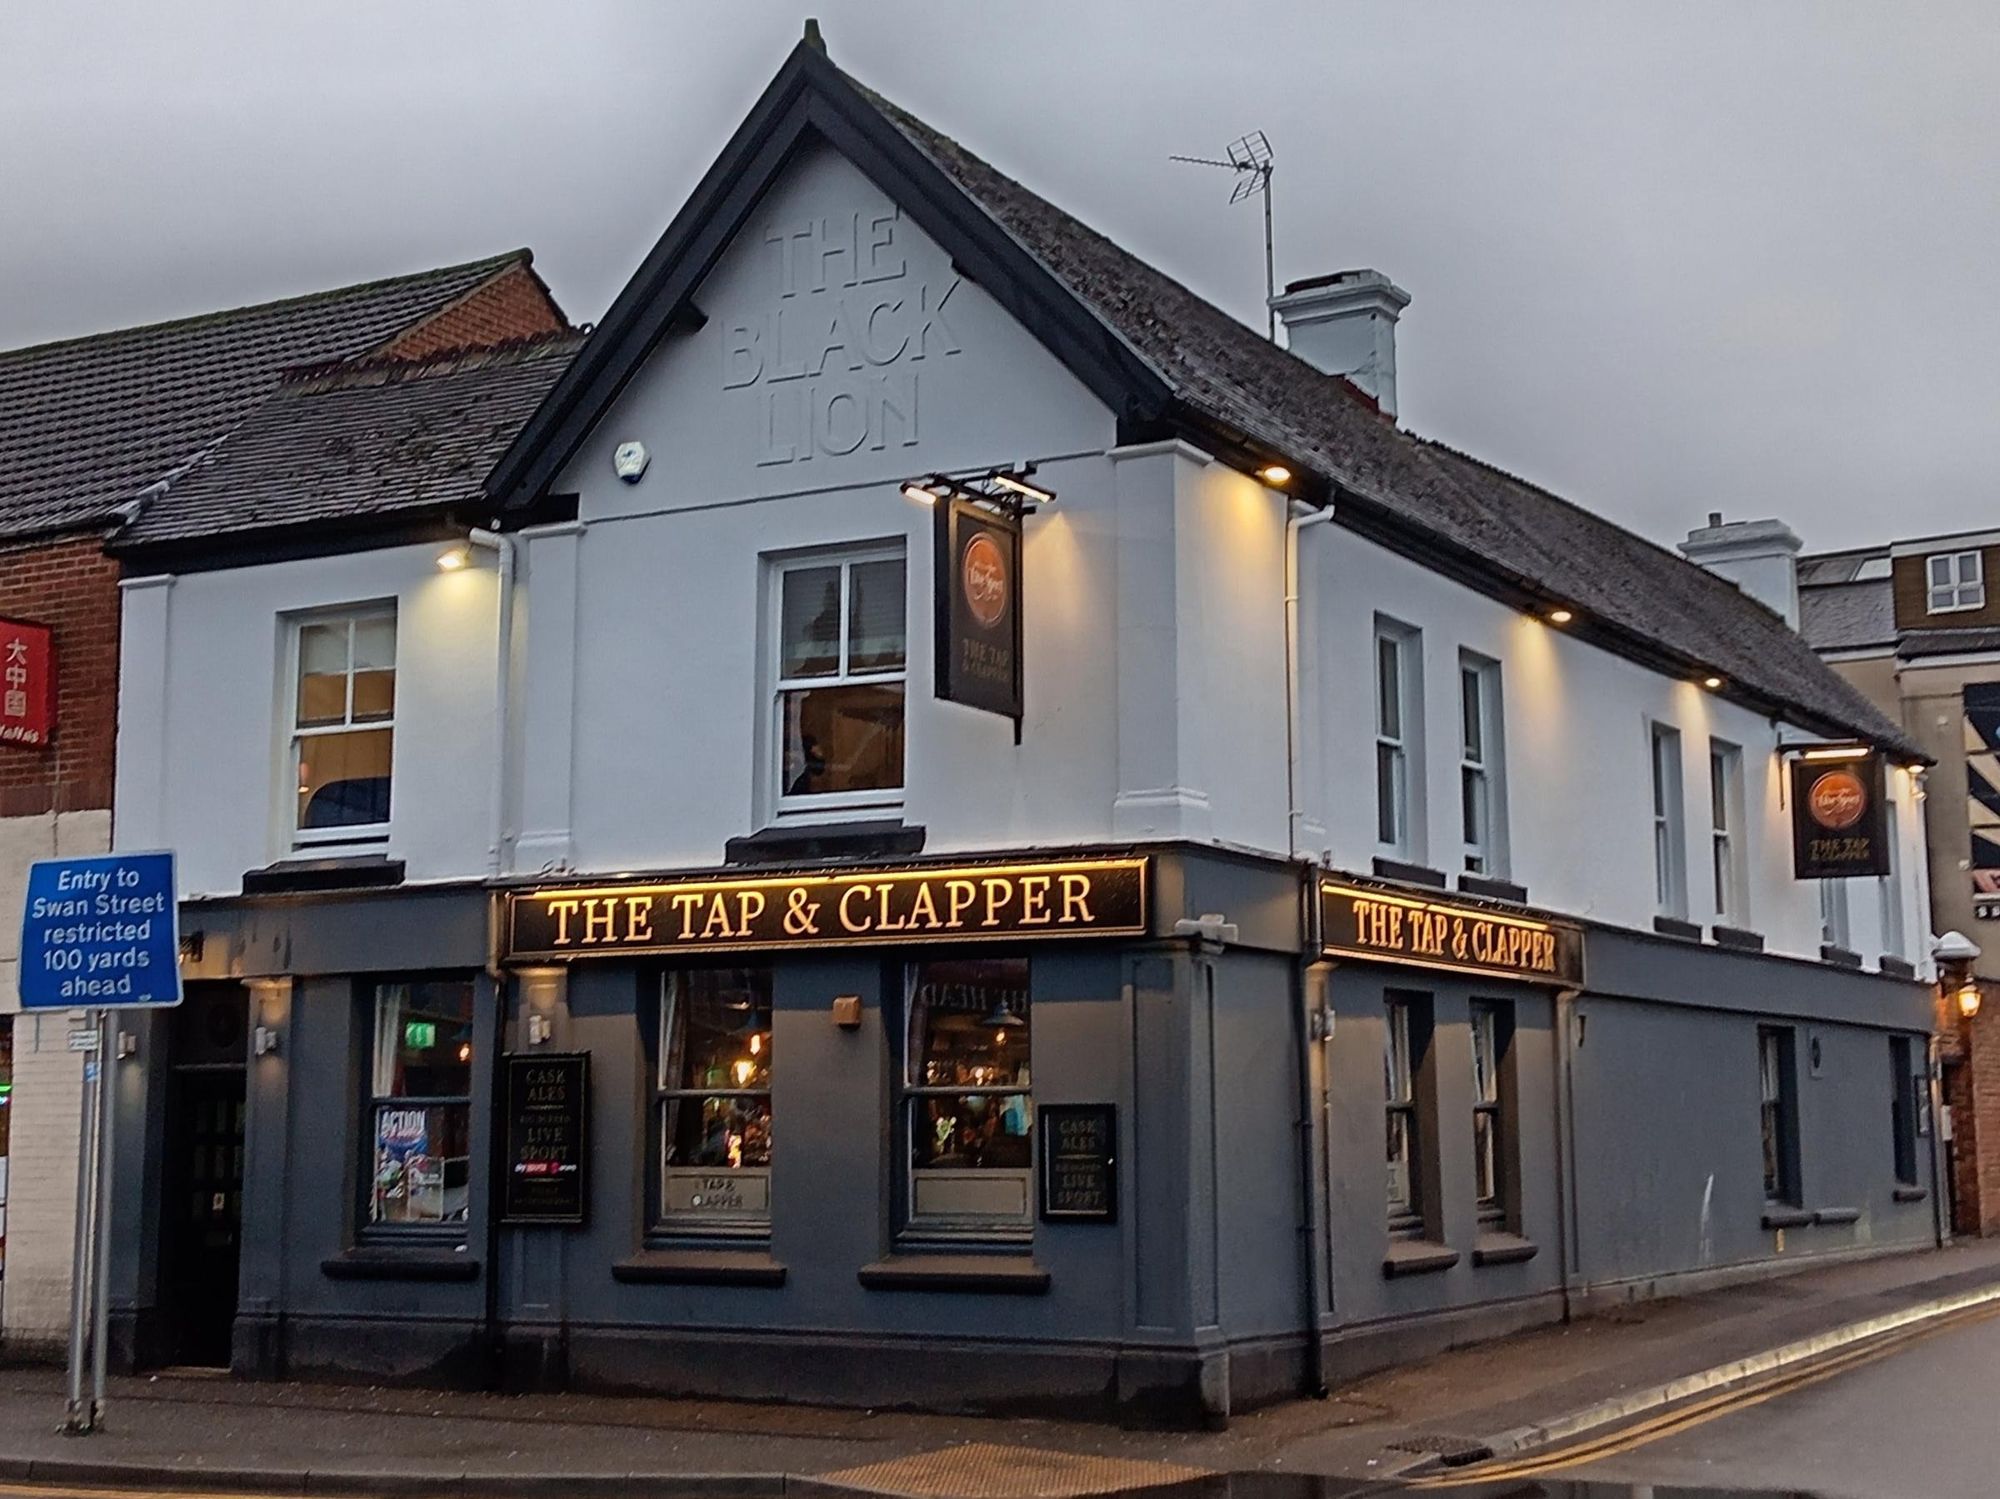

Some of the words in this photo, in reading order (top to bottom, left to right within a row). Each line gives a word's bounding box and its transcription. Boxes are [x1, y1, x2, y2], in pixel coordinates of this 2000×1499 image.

[764, 205, 906, 299] THE
[721, 277, 963, 391] BLACK
[756, 373, 919, 467] LION
[57, 869, 112, 893] Entry
[116, 867, 139, 888] to
[32, 896, 89, 919] Swan
[95, 891, 165, 916] Street
[547, 896, 653, 945] THE
[671, 890, 766, 940] TAP
[782, 887, 821, 935] &
[838, 873, 1096, 932] CLAPPER
[43, 918, 151, 945] restricted
[1352, 900, 1405, 949] THE
[1407, 910, 1448, 956] TAP
[1452, 917, 1470, 959] &
[1472, 921, 1556, 971] CLAPPER
[43, 948, 83, 971] 100
[88, 945, 150, 973] yards
[59, 973, 132, 997] ahead
